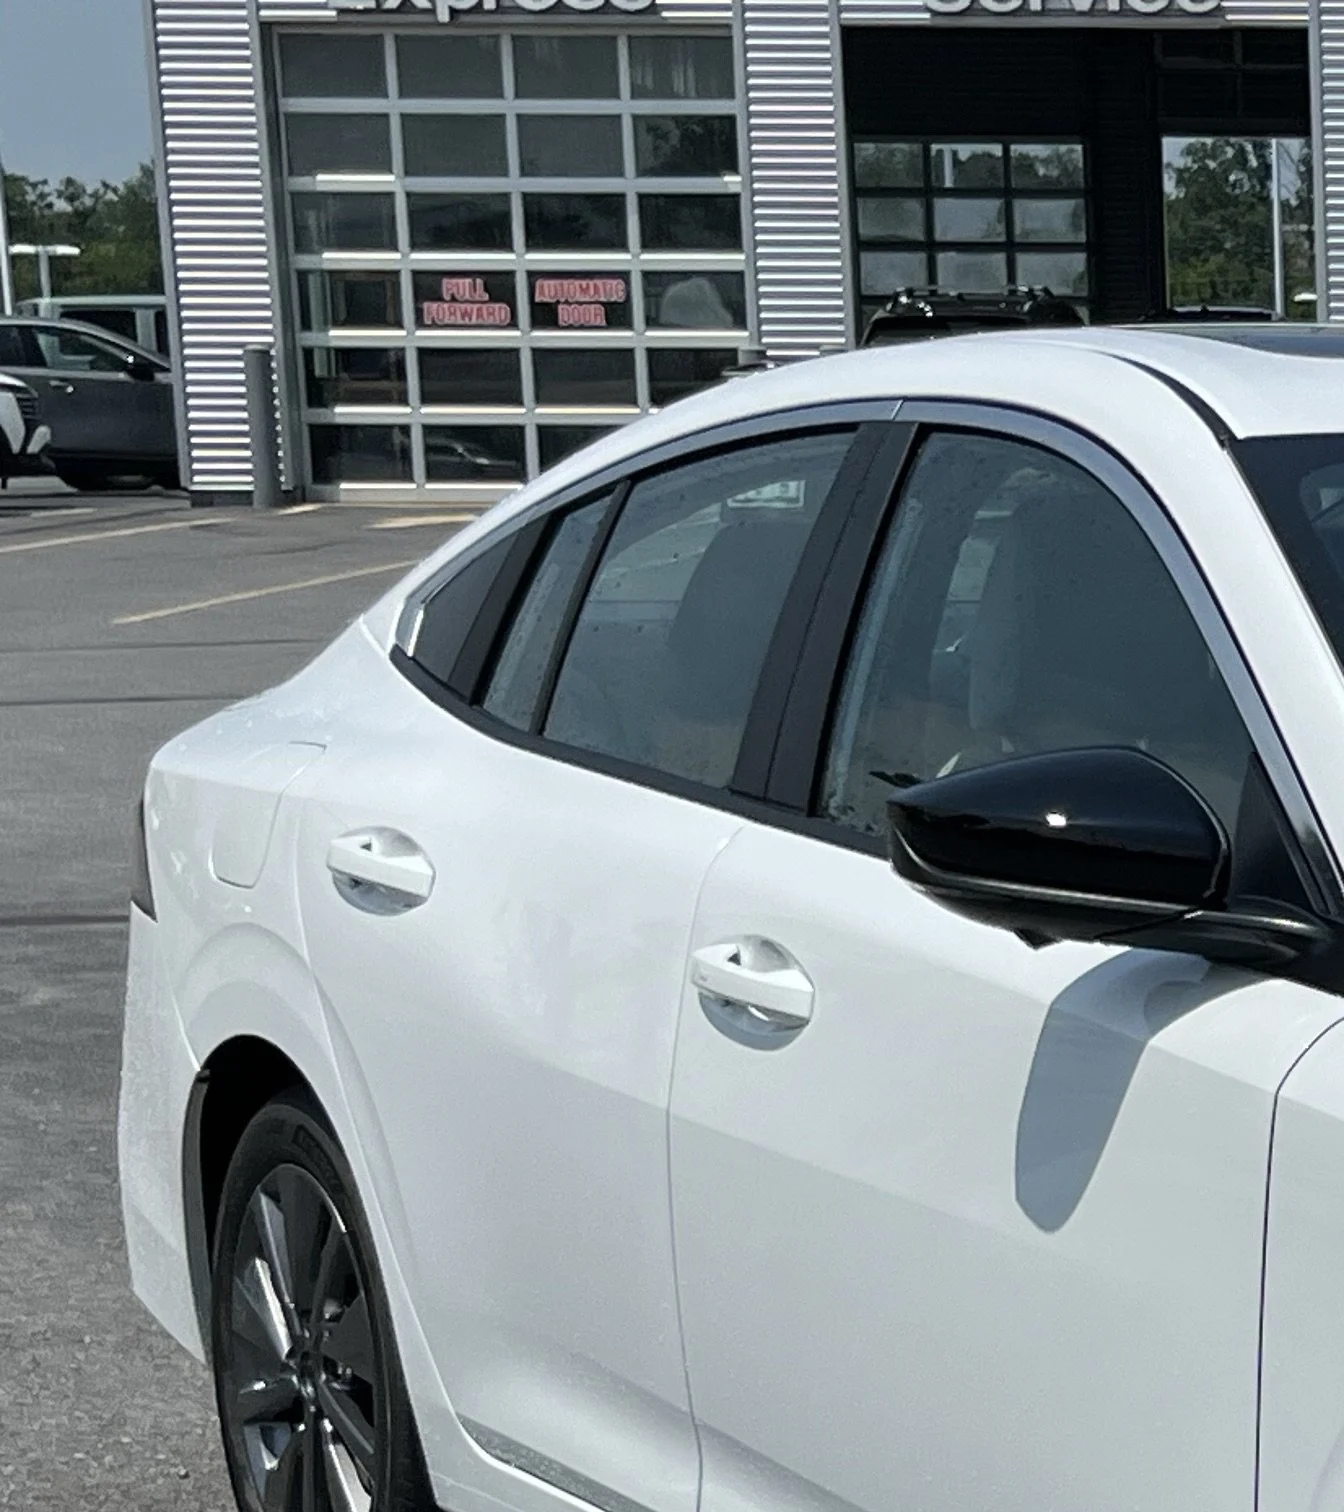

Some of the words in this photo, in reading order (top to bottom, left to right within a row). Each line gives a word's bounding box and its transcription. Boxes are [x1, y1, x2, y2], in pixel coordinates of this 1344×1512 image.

[442, 278, 489, 301] PULL
[535, 279, 626, 303] AUTOMATIC
[423, 302, 511, 325] FORWARD
[558, 304, 607, 327] DOOR
